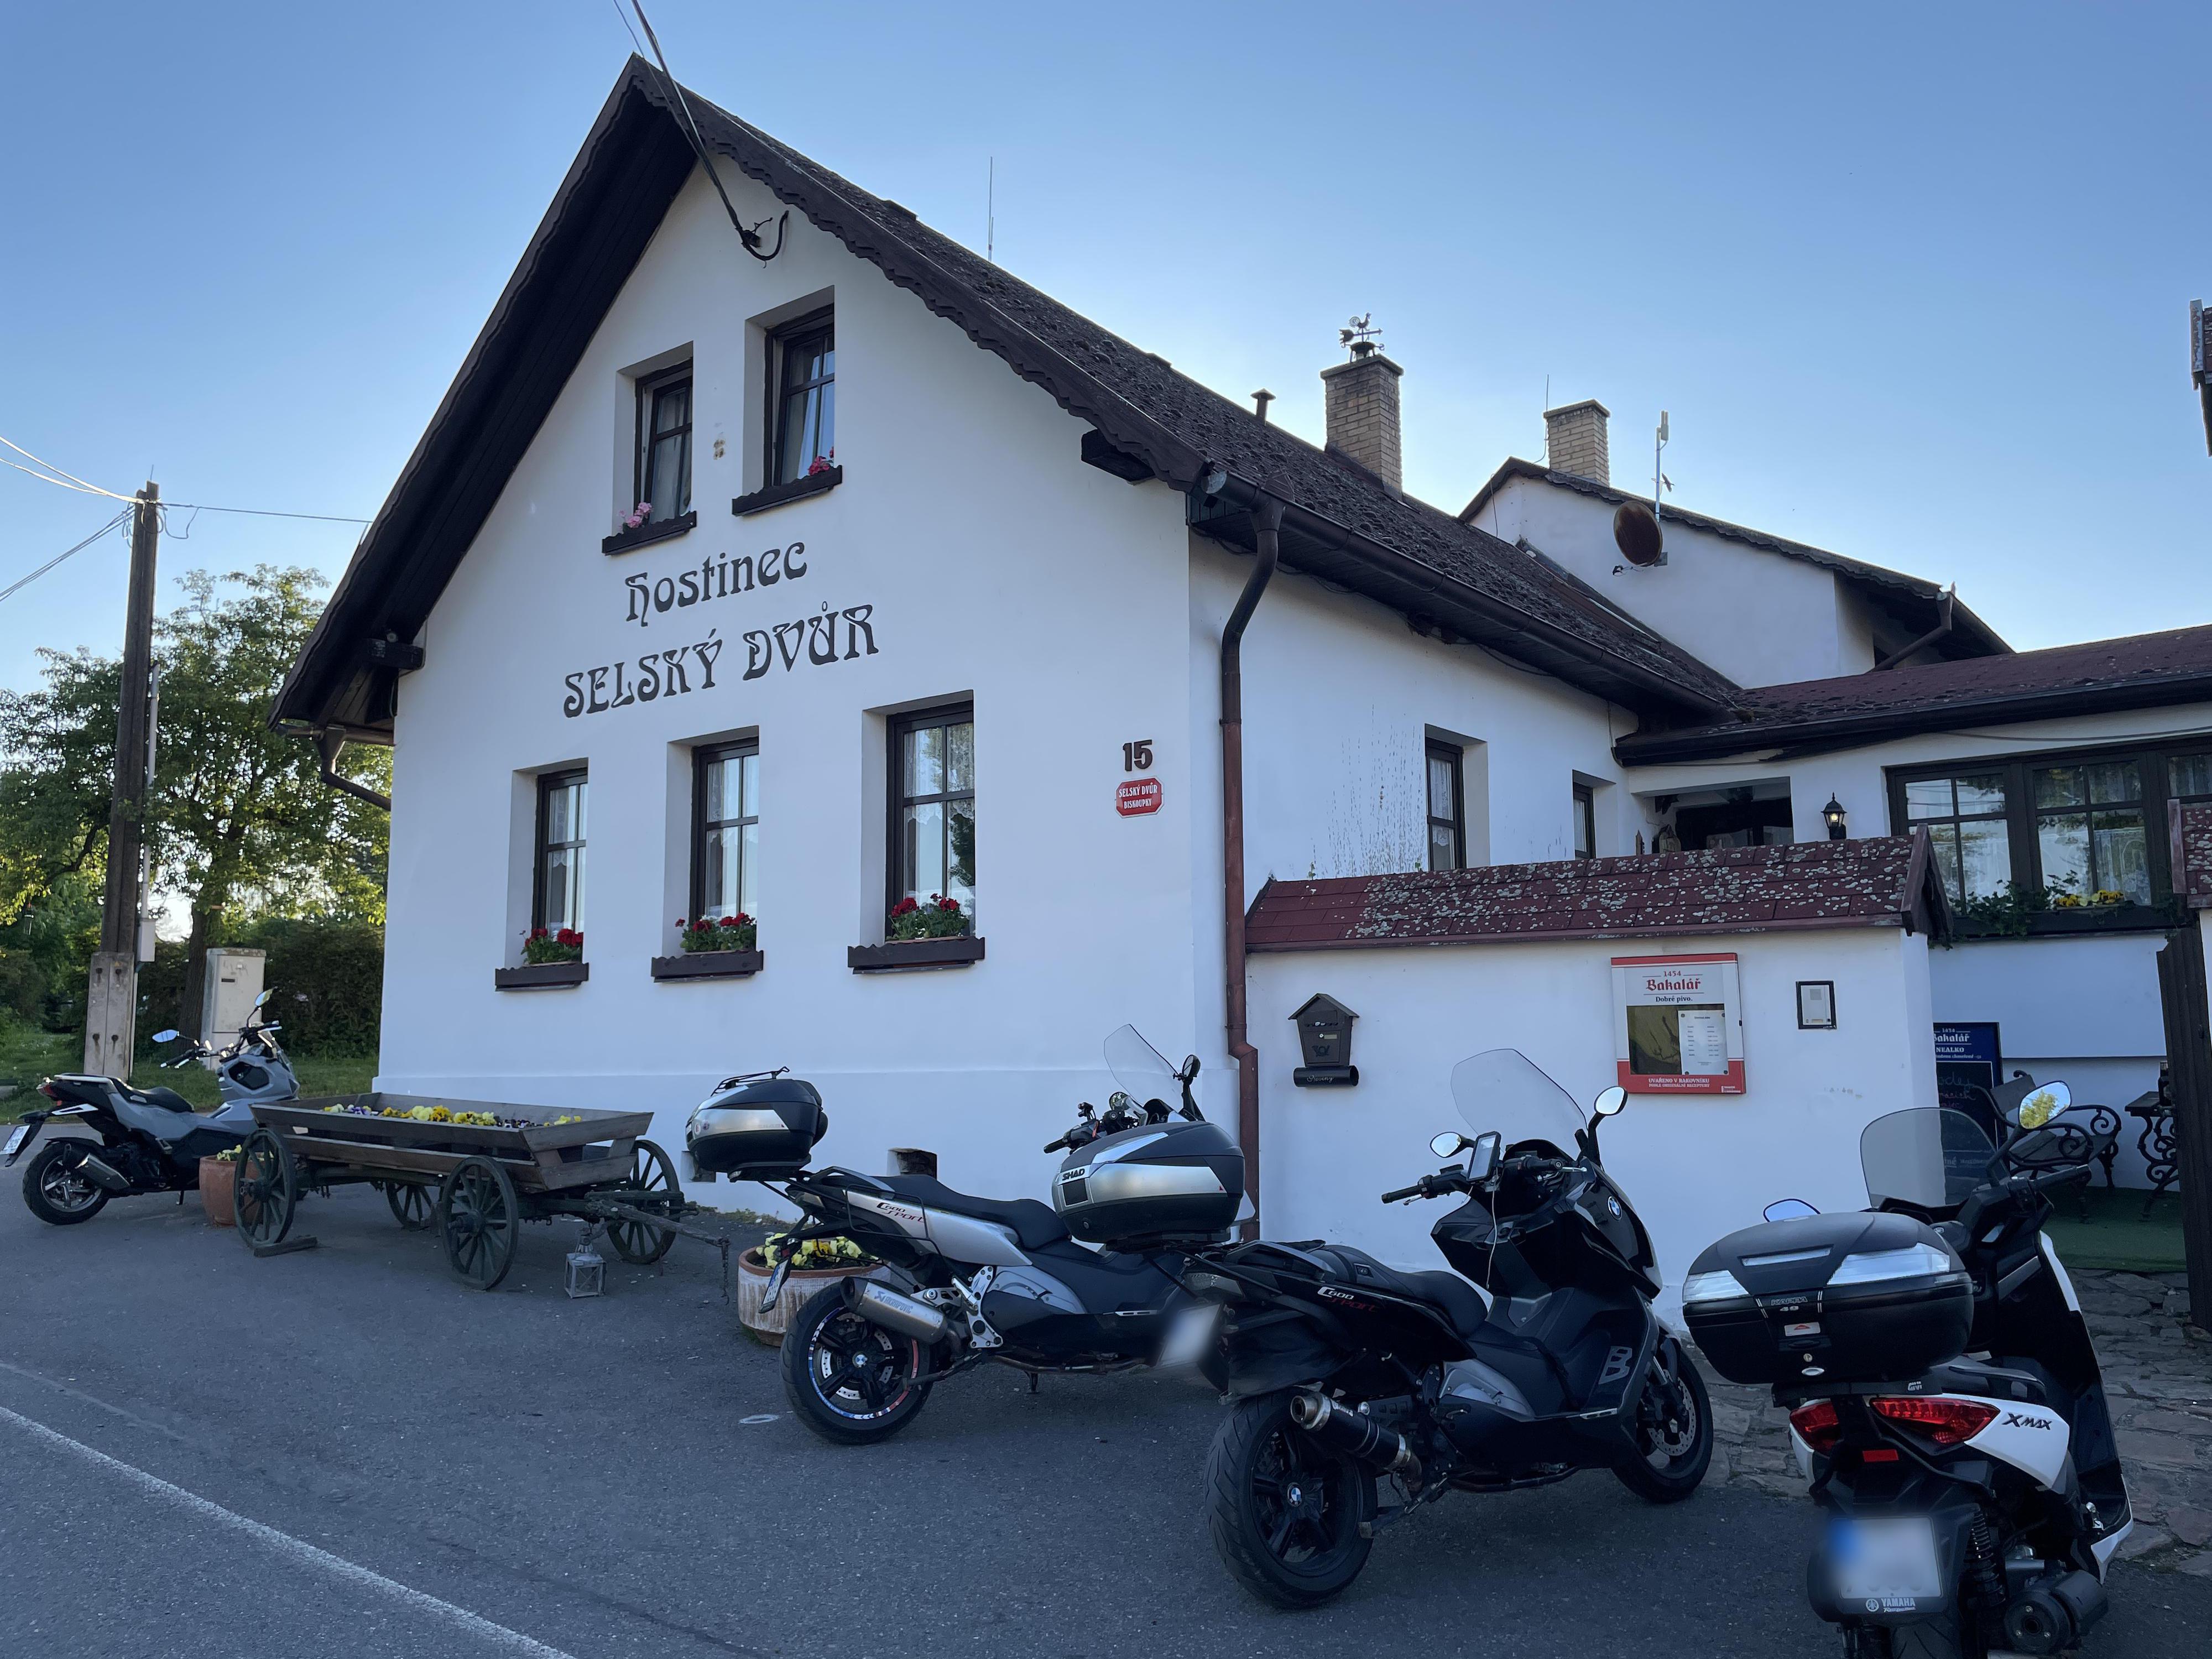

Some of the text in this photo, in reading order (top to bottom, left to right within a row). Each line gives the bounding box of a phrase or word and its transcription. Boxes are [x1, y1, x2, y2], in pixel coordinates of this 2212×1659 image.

[563, 601, 879, 718] SELSKÝ DVŮR
[1123, 739, 1153, 771] 15
[1119, 782, 1157, 798] SELSKÝ DVŮR
[1124, 798, 1152, 809] BISKOUPKY
[1646, 978, 1701, 991] Bakalář
[1062, 1168, 1085, 1181] SHAD
[1318, 1286, 1354, 1300] C600
[1881, 1597, 1916, 1607] YAMAHA
